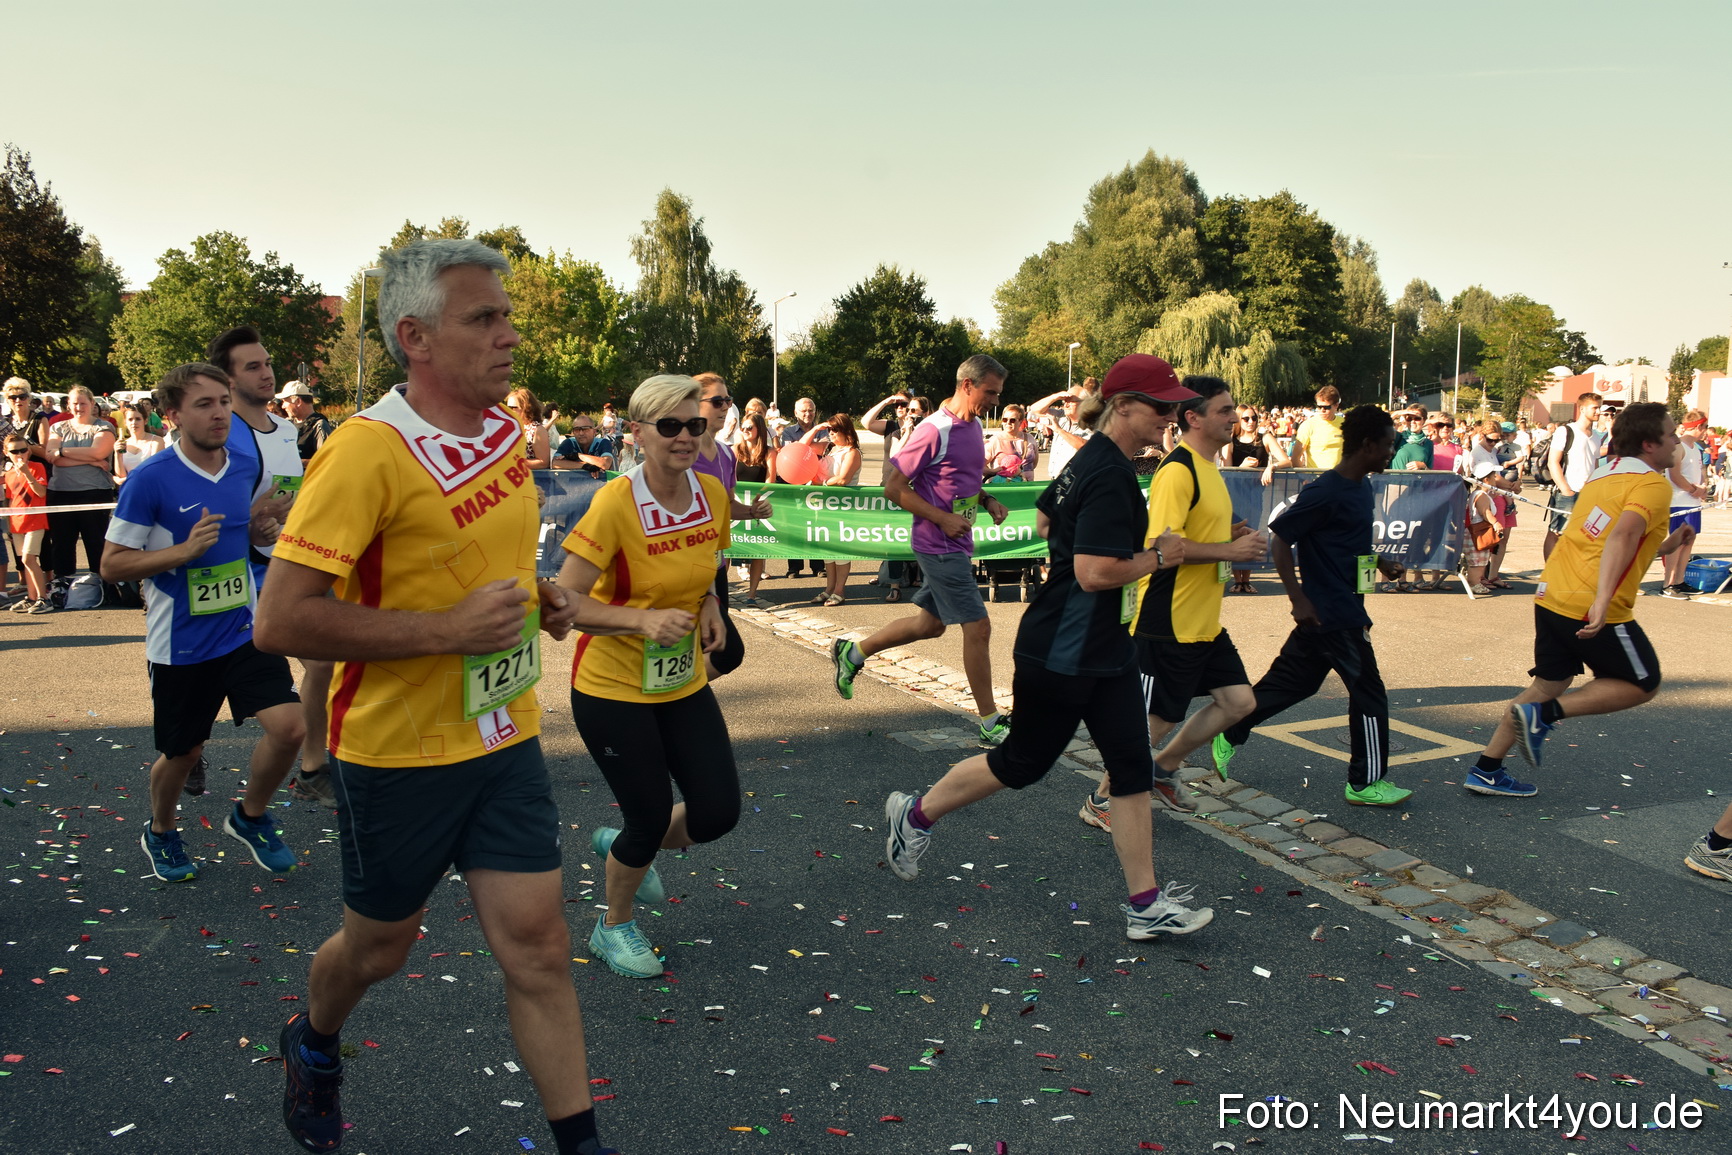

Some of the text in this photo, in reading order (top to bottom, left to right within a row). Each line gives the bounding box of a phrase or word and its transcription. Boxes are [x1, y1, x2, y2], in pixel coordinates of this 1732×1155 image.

[450, 479, 509, 529] MAX
[648, 527, 719, 556] MAX BÖGL
[806, 521, 830, 542] in
[839, 521, 911, 542] beste
[197, 577, 243, 602] 2119
[478, 641, 533, 692] 1271
[653, 650, 694, 677] 1288
